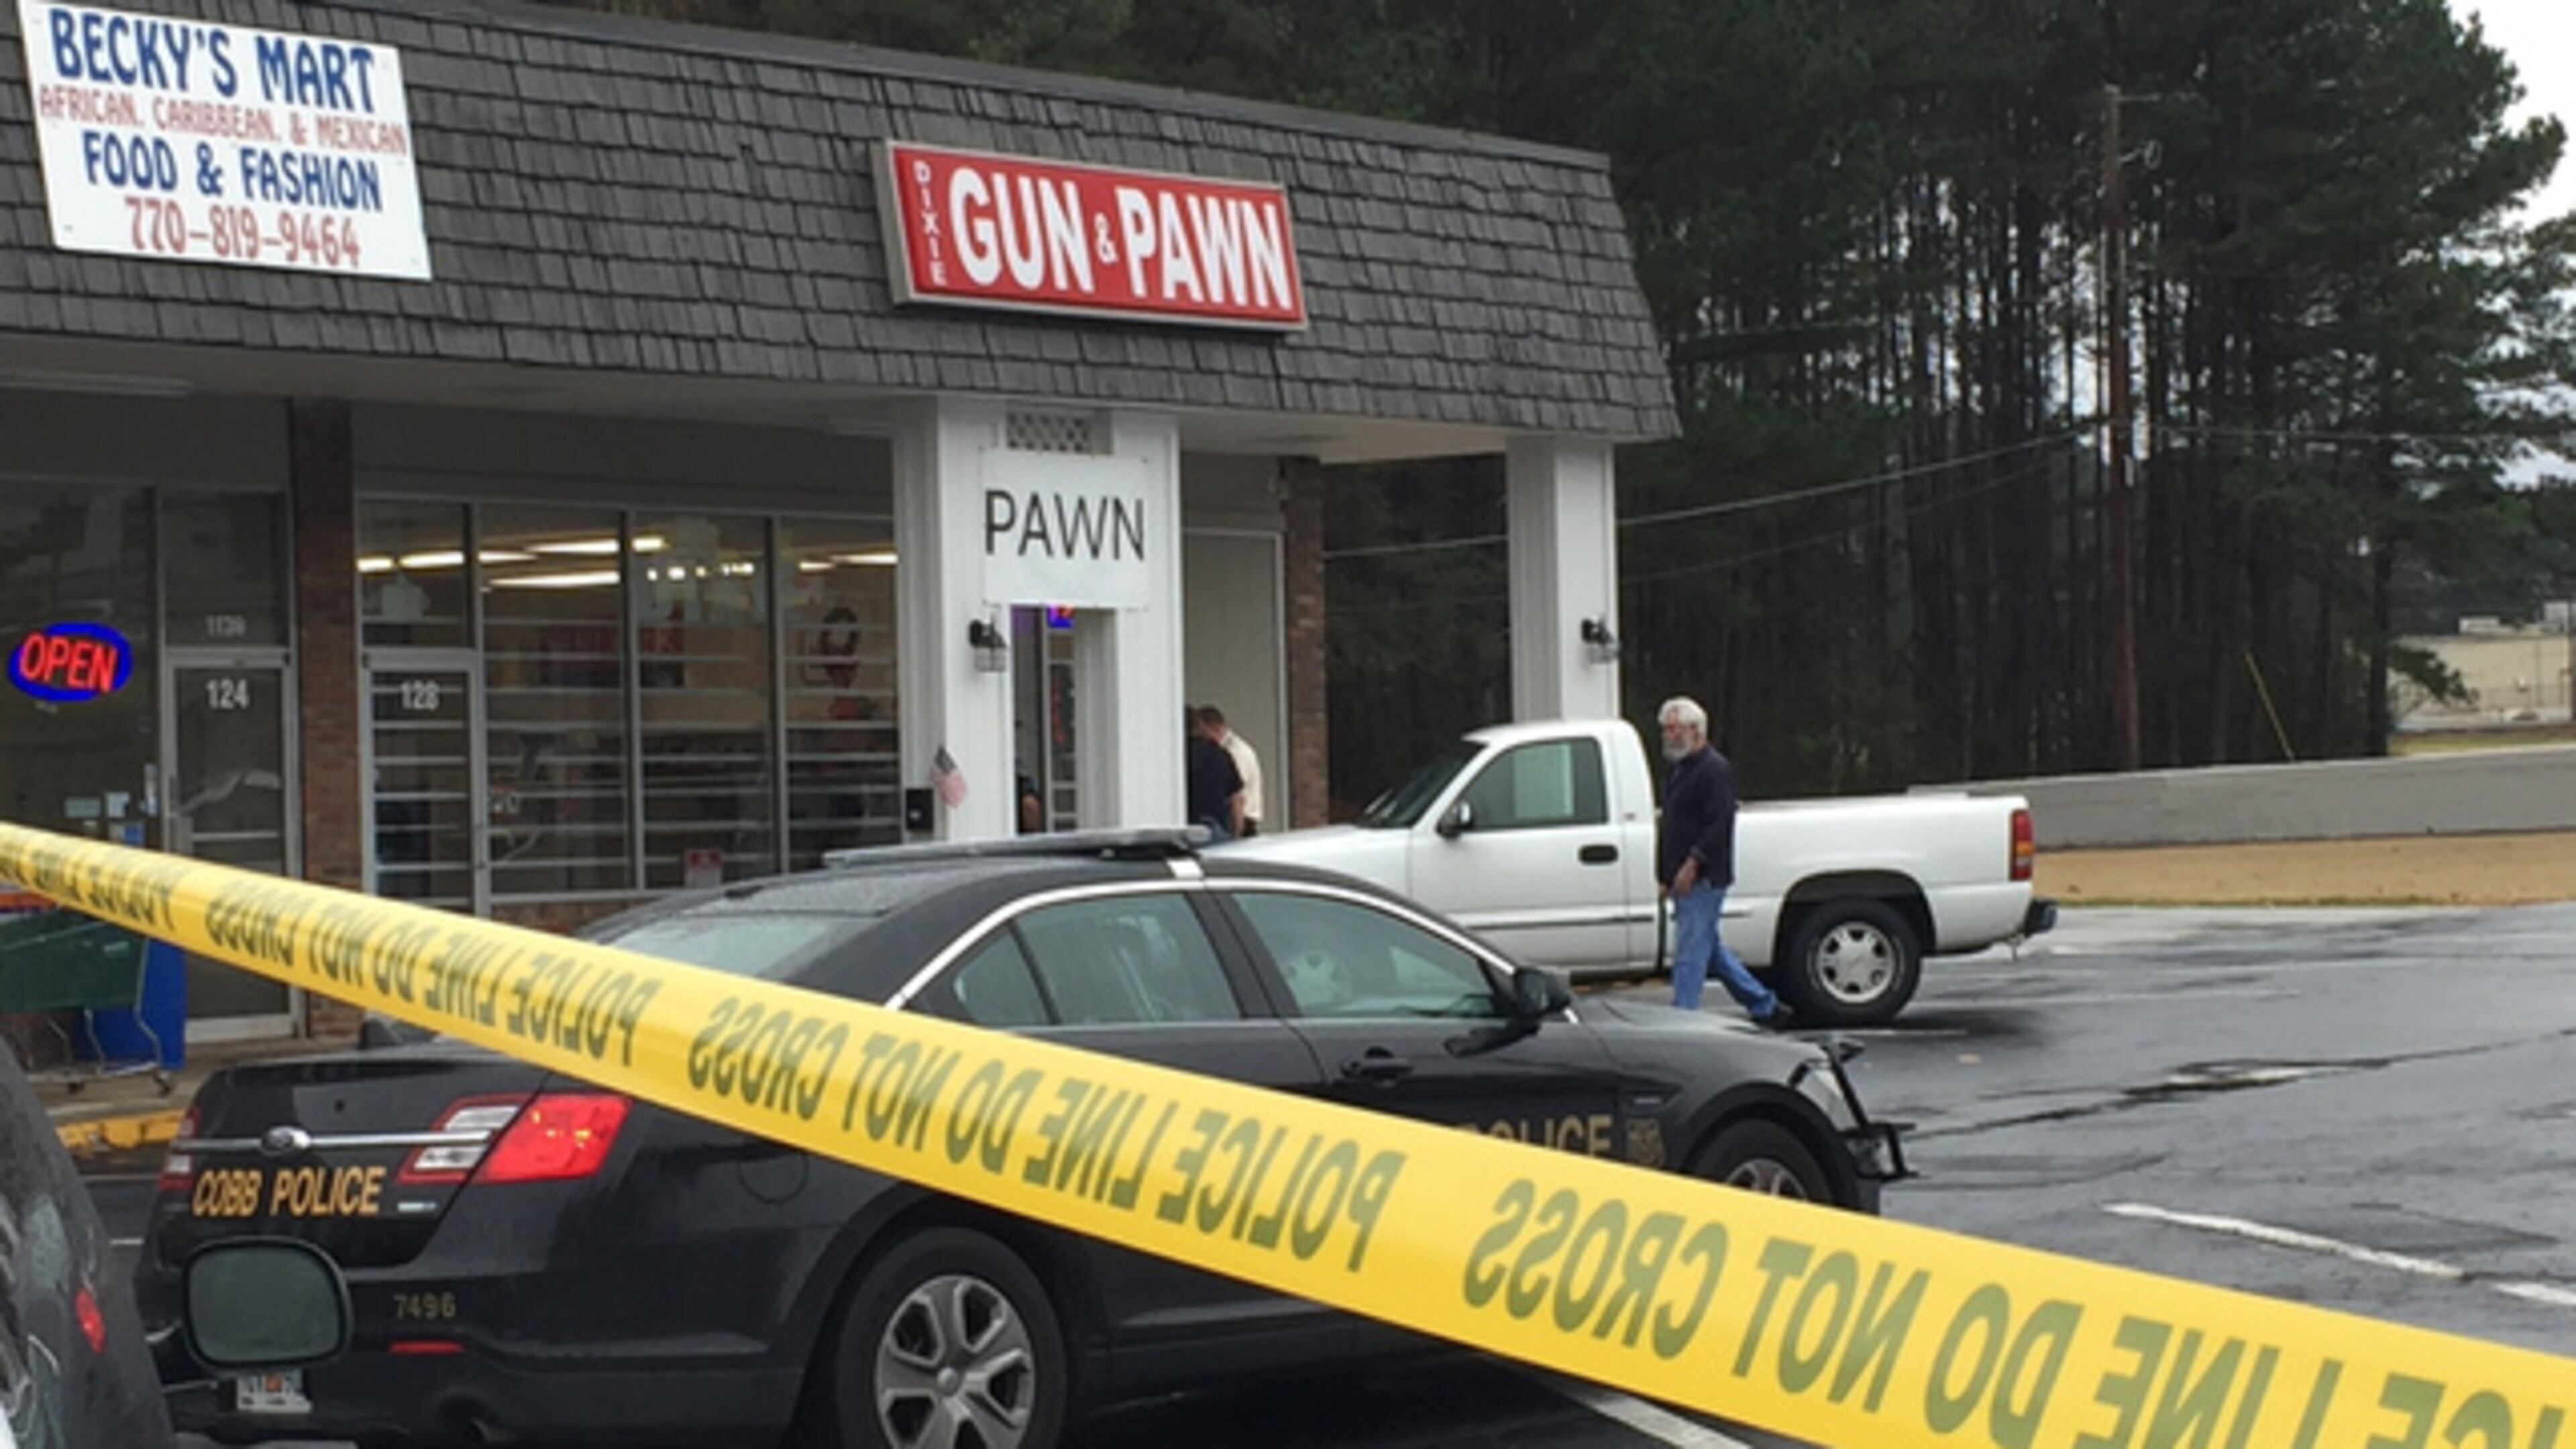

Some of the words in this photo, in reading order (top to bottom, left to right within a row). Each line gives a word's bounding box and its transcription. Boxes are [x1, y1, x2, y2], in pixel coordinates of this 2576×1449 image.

[50, 8, 239, 98] BECKY'S
[255, 36, 376, 113] MART
[290, 112, 307, 145] &
[317, 115, 408, 156] MEXICAN
[83, 130, 178, 192] FOOD
[196, 143, 223, 197] &
[240, 146, 383, 213] FASHION
[123, 196, 360, 268] 770-819-9464
[914, 161, 947, 287] DIXIE
[949, 166, 1094, 294] GUN
[1095, 213, 1118, 264] &
[1116, 185, 1293, 310] PAWN
[984, 489, 1144, 562] PAWN
[18, 632, 118, 693] OPEN
[205, 678, 250, 709] 124
[401, 680, 440, 711] 128
[192, 1170, 262, 1217] COBB
[270, 1166, 386, 1217] POLICE
[393, 1295, 456, 1318] 7496
